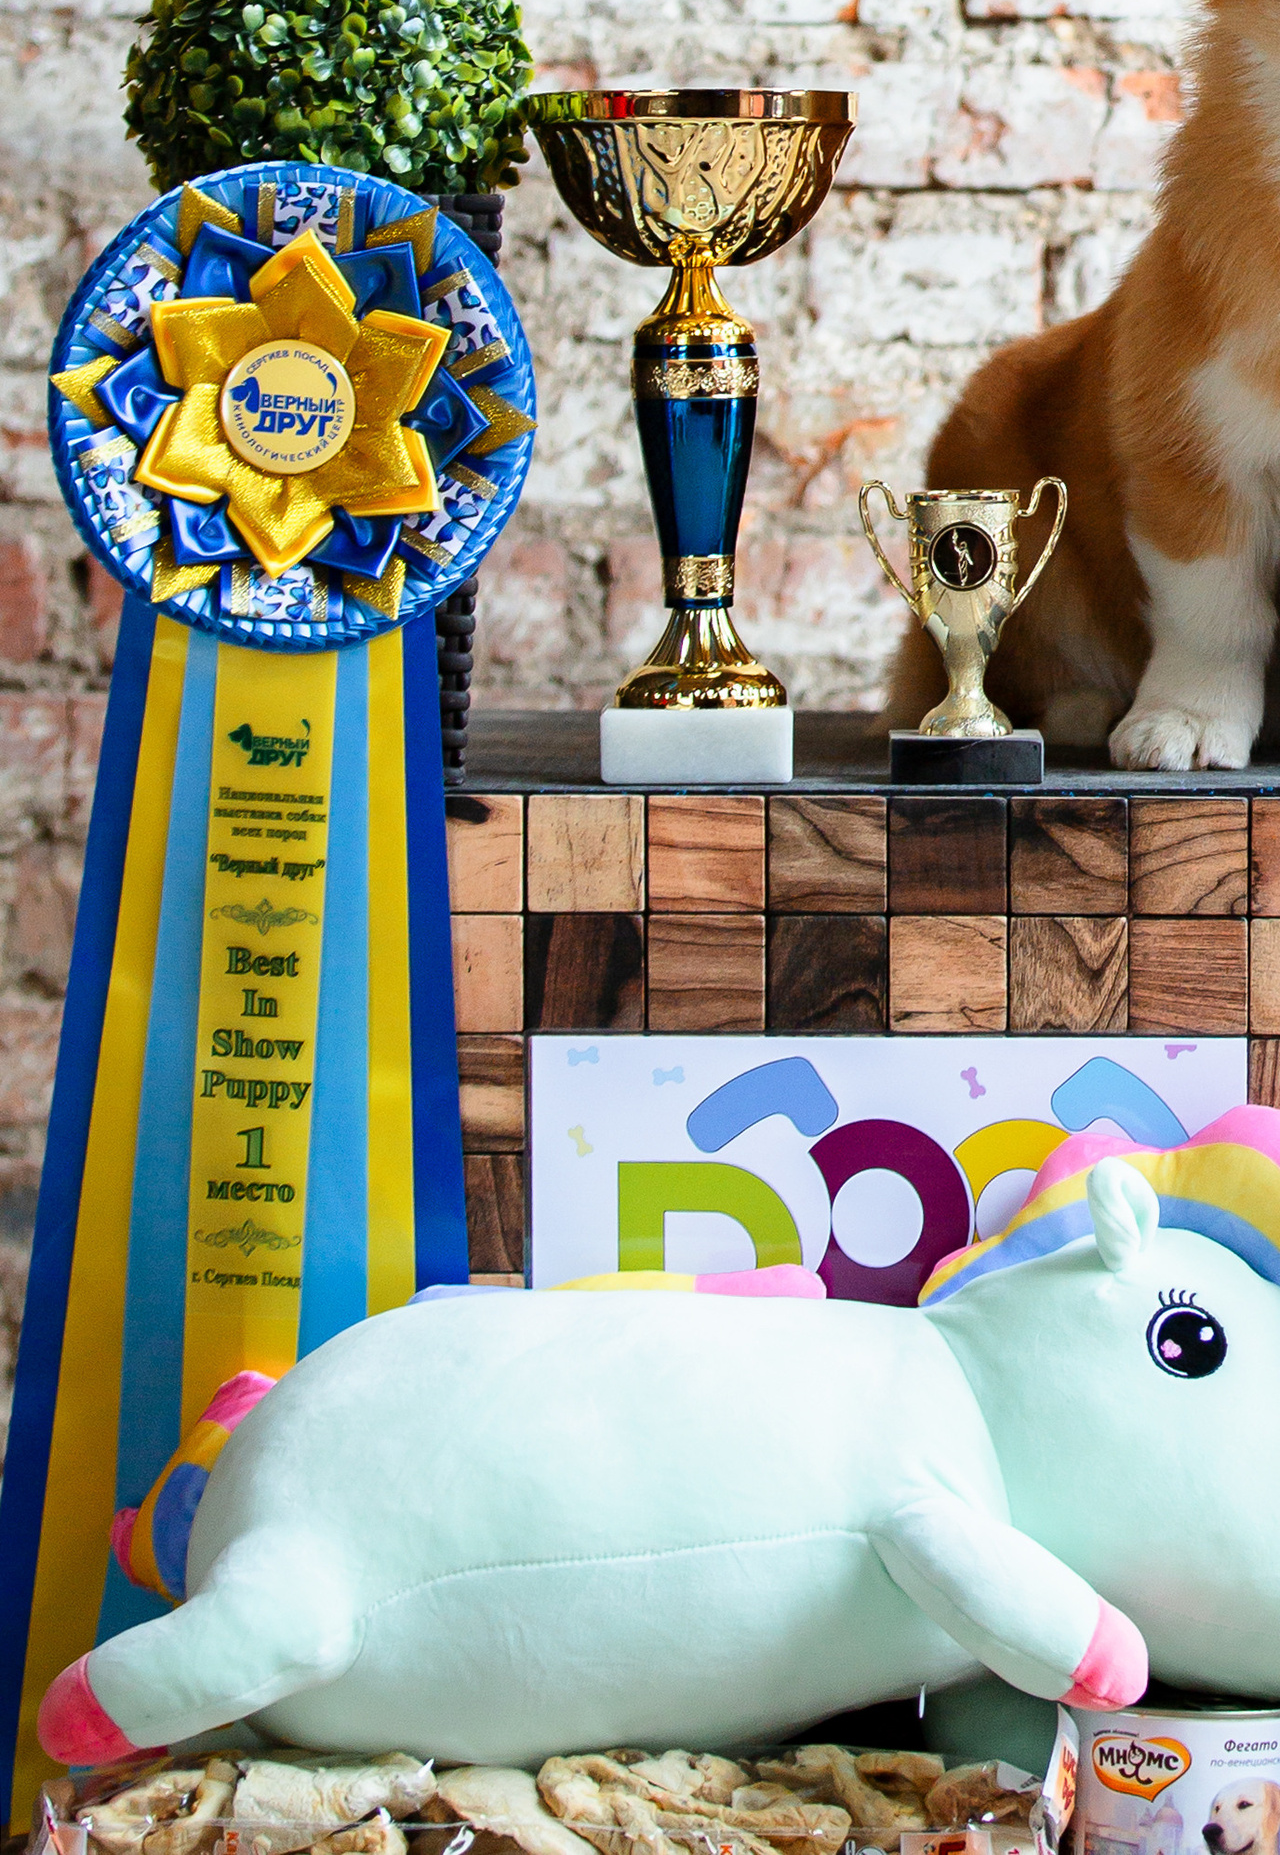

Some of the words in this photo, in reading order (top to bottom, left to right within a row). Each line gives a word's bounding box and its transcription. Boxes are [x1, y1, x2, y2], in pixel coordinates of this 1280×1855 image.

[246, 350, 289, 374] СЕРГИЕВ
[294, 350, 328, 373] ПОСАД
[234, 404, 329, 462] КИНОЛОГИЧЕСКИЙ
[328, 399, 345, 440] ЦЕНТР
[252, 410, 334, 437] ДРУГ
[247, 749, 308, 767] ДРУГ
[218, 786, 324, 804] Национальная
[214, 808, 282, 820] выставка
[286, 810, 326, 823] собак
[231, 827, 262, 837] всех
[266, 828, 307, 842] пород
[225, 947, 299, 977] Best
[241, 989, 278, 1017] In
[211, 1028, 304, 1060] Show
[200, 1070, 312, 1110] Puppy
[236, 1126, 271, 1169] 1
[206, 1181, 295, 1203] место
[204, 1269, 257, 1288] Сергиев
[261, 1272, 301, 1289] Посад
[1224, 1740, 1278, 1753] Фегато
